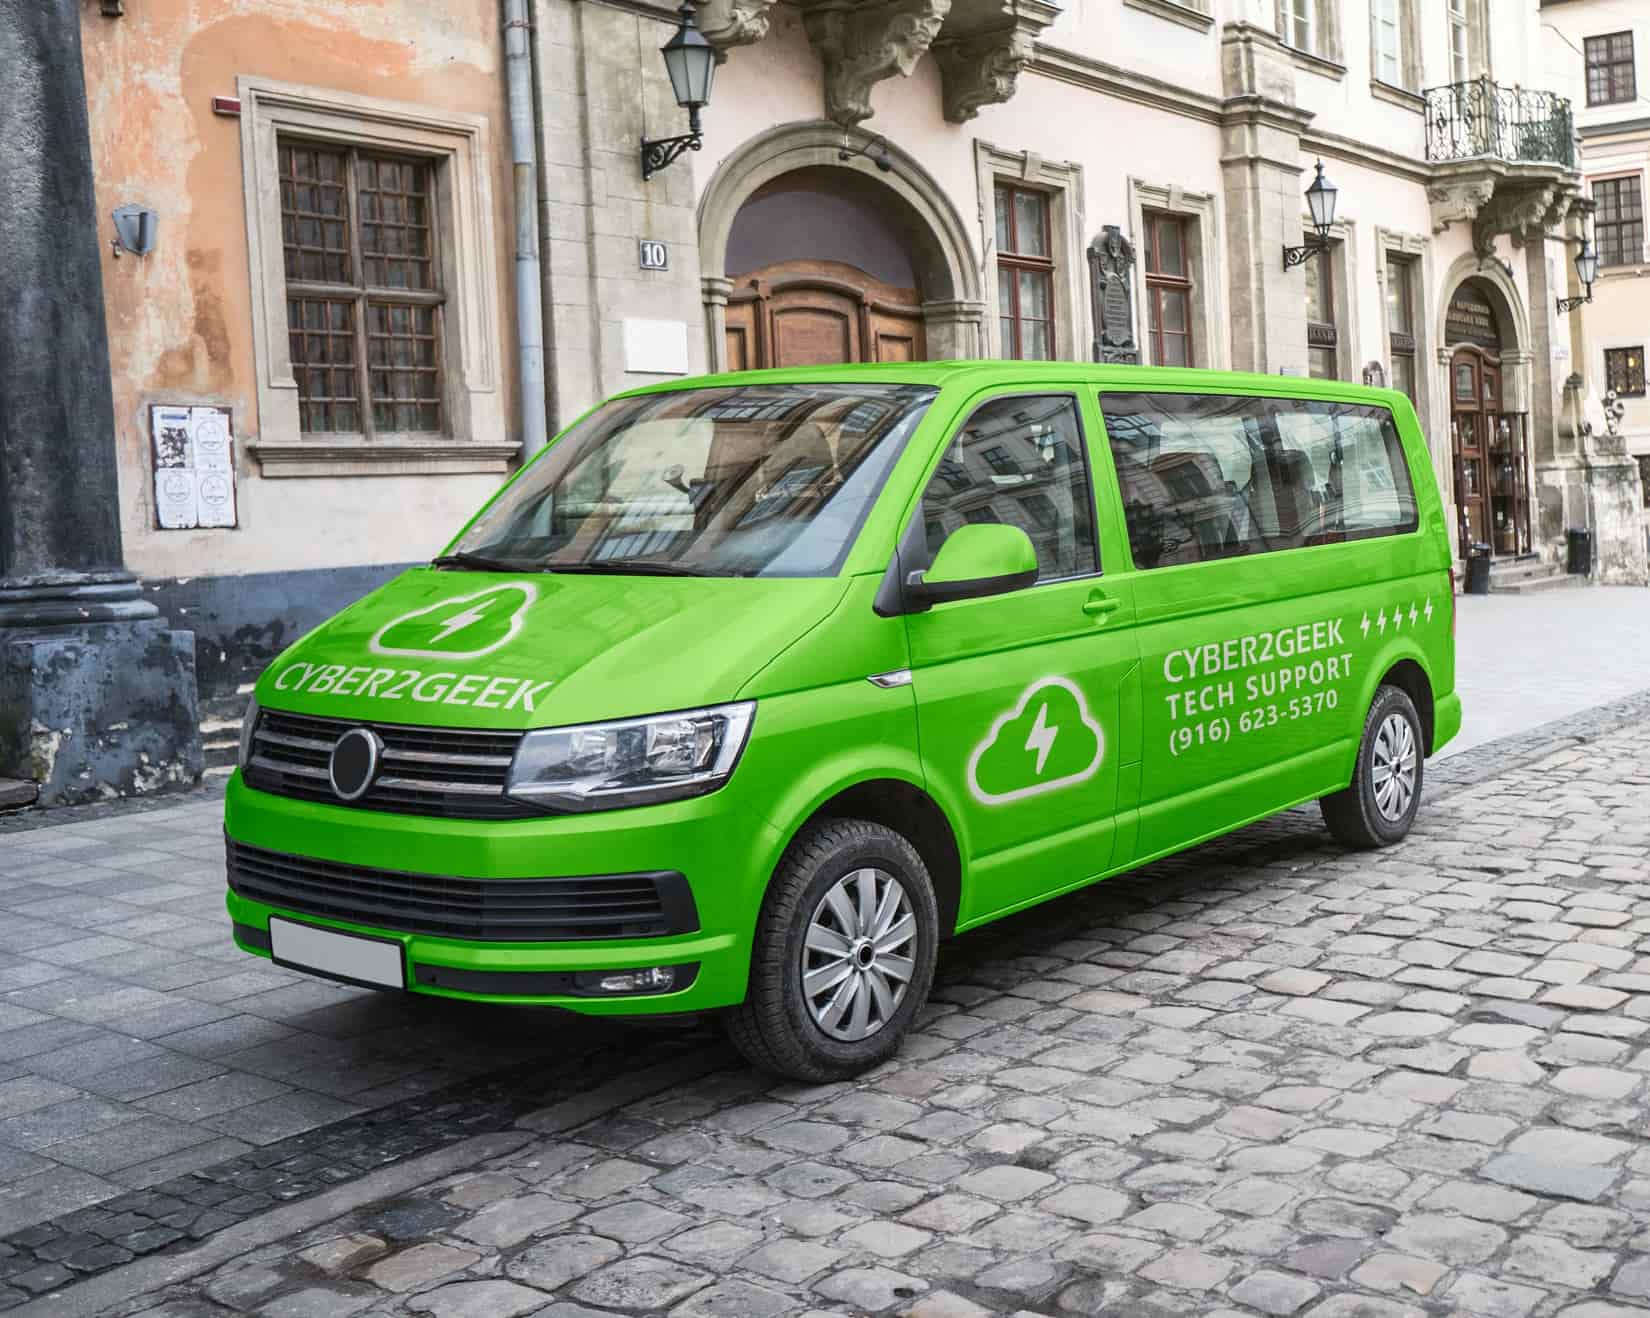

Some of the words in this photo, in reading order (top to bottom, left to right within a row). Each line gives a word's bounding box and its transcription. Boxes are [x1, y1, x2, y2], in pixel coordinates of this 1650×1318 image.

[644, 244, 665, 266] 10
[1164, 618, 1344, 683] CYBER2GEEK
[274, 662, 553, 712] CYBER2GEEK
[1166, 682, 1234, 720] TECH
[1247, 653, 1353, 700] SUPPORT
[1169, 718, 1230, 756] (916)
[1239, 689, 1338, 733] 623-5370
